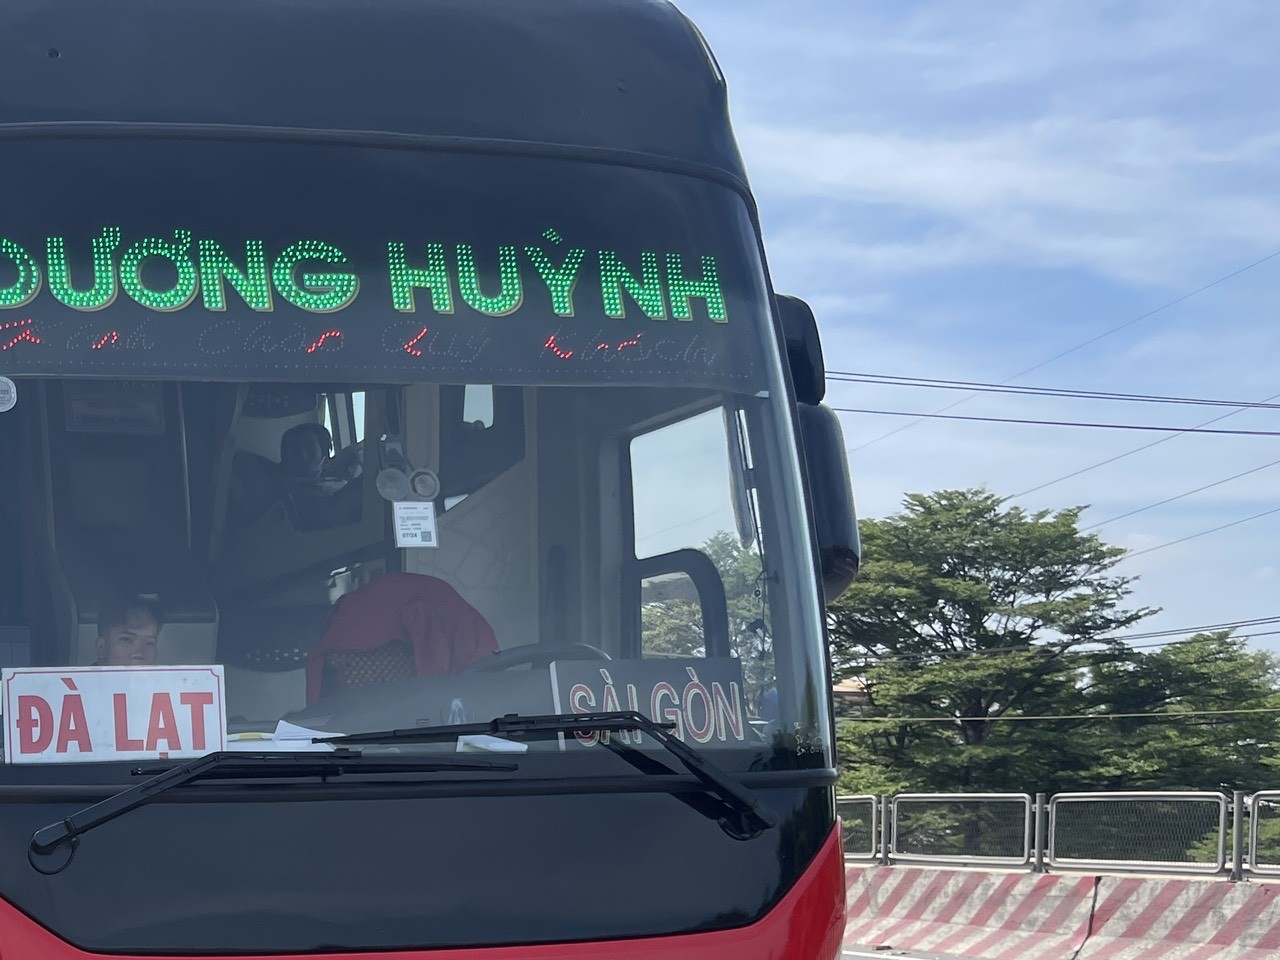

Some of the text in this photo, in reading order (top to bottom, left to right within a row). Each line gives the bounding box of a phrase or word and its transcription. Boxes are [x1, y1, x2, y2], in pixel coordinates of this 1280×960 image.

[387, 227, 729, 324] HUỲNH
[16, 677, 214, 761] ĐÀ LẠT
[569, 668, 643, 747] SÀI
[650, 666, 745, 744] GÒN
